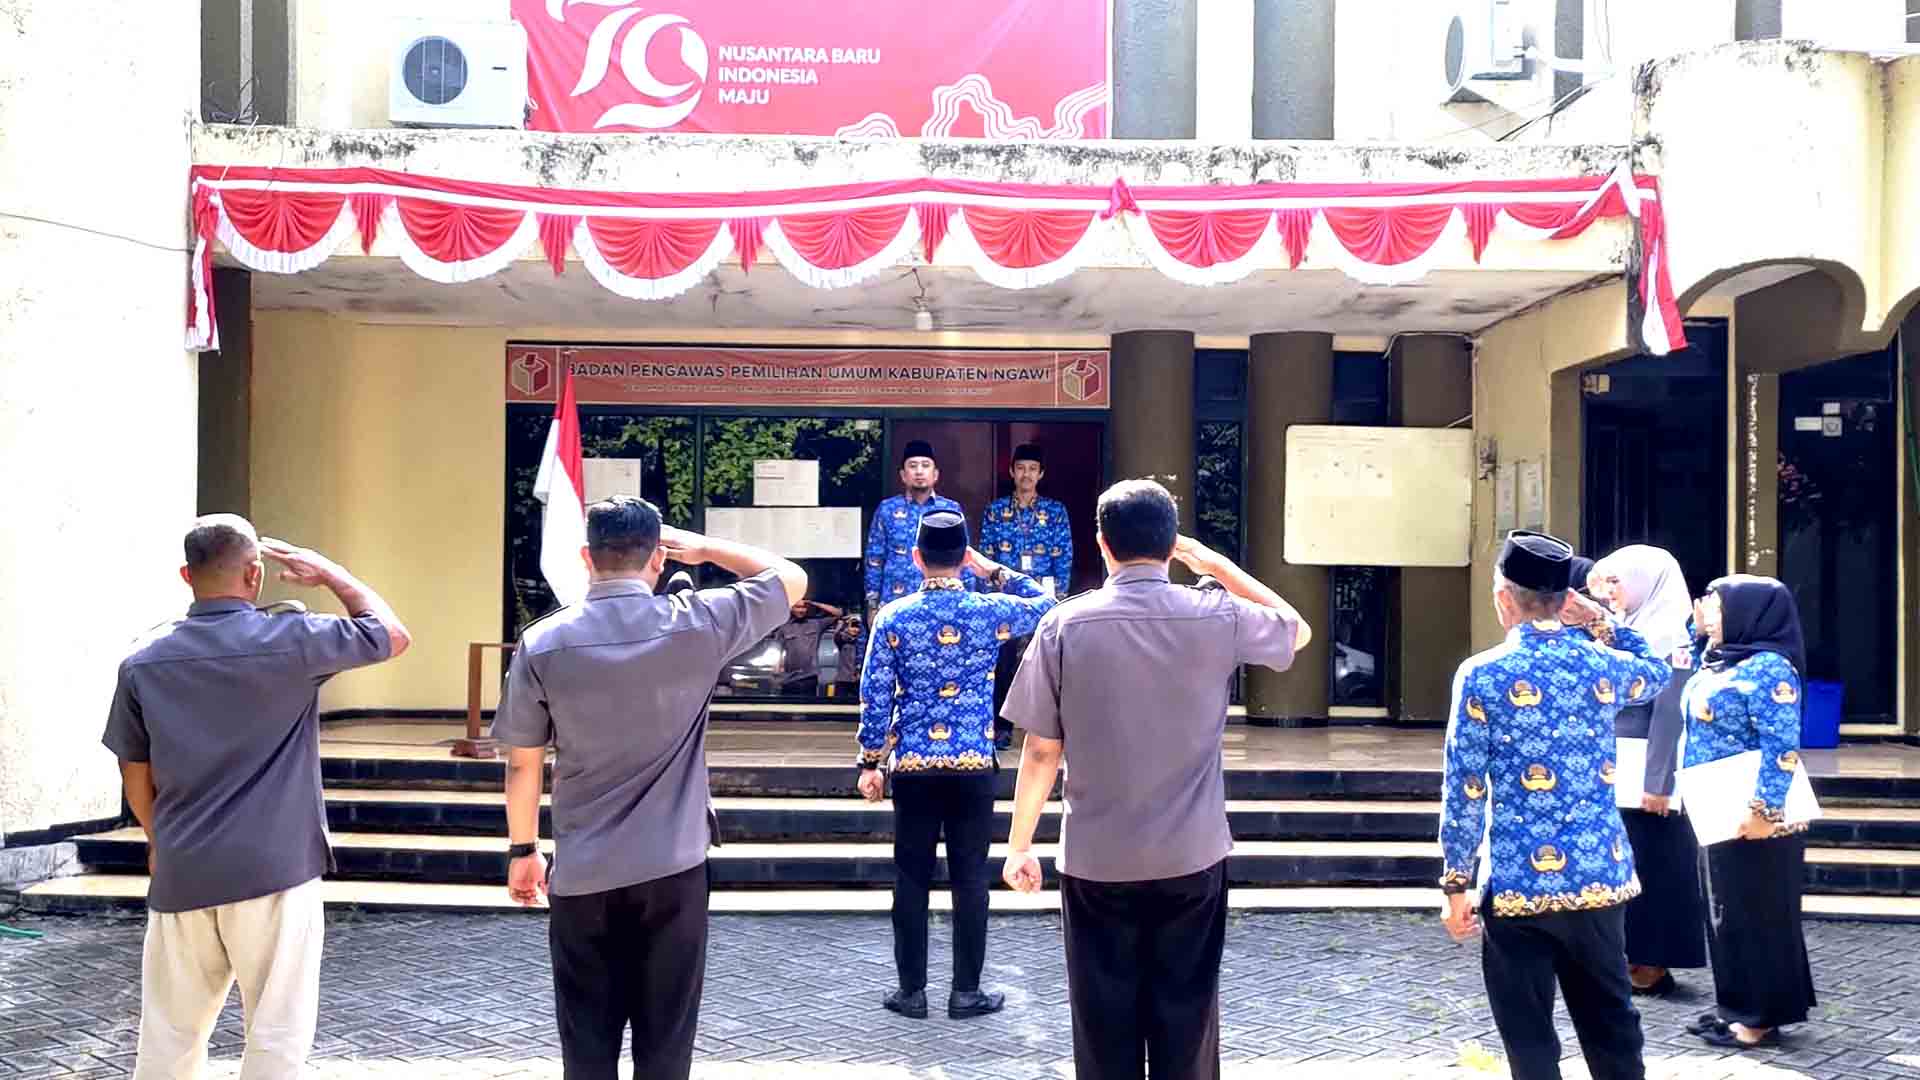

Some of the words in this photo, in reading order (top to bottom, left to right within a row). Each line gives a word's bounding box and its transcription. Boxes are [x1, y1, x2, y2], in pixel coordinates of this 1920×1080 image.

[719, 47, 829, 63] NUSANTARA
[832, 48, 881, 64] BARU
[719, 67, 819, 84] INDONESIA
[719, 89, 770, 104] MAJU
[631, 364, 725, 377] PENGAWAS
[731, 366, 822, 378] PEMILIHAN
[828, 367, 882, 379] UMUM
[888, 367, 987, 380] KABUPATEN
[993, 368, 1049, 380] NGAWI
